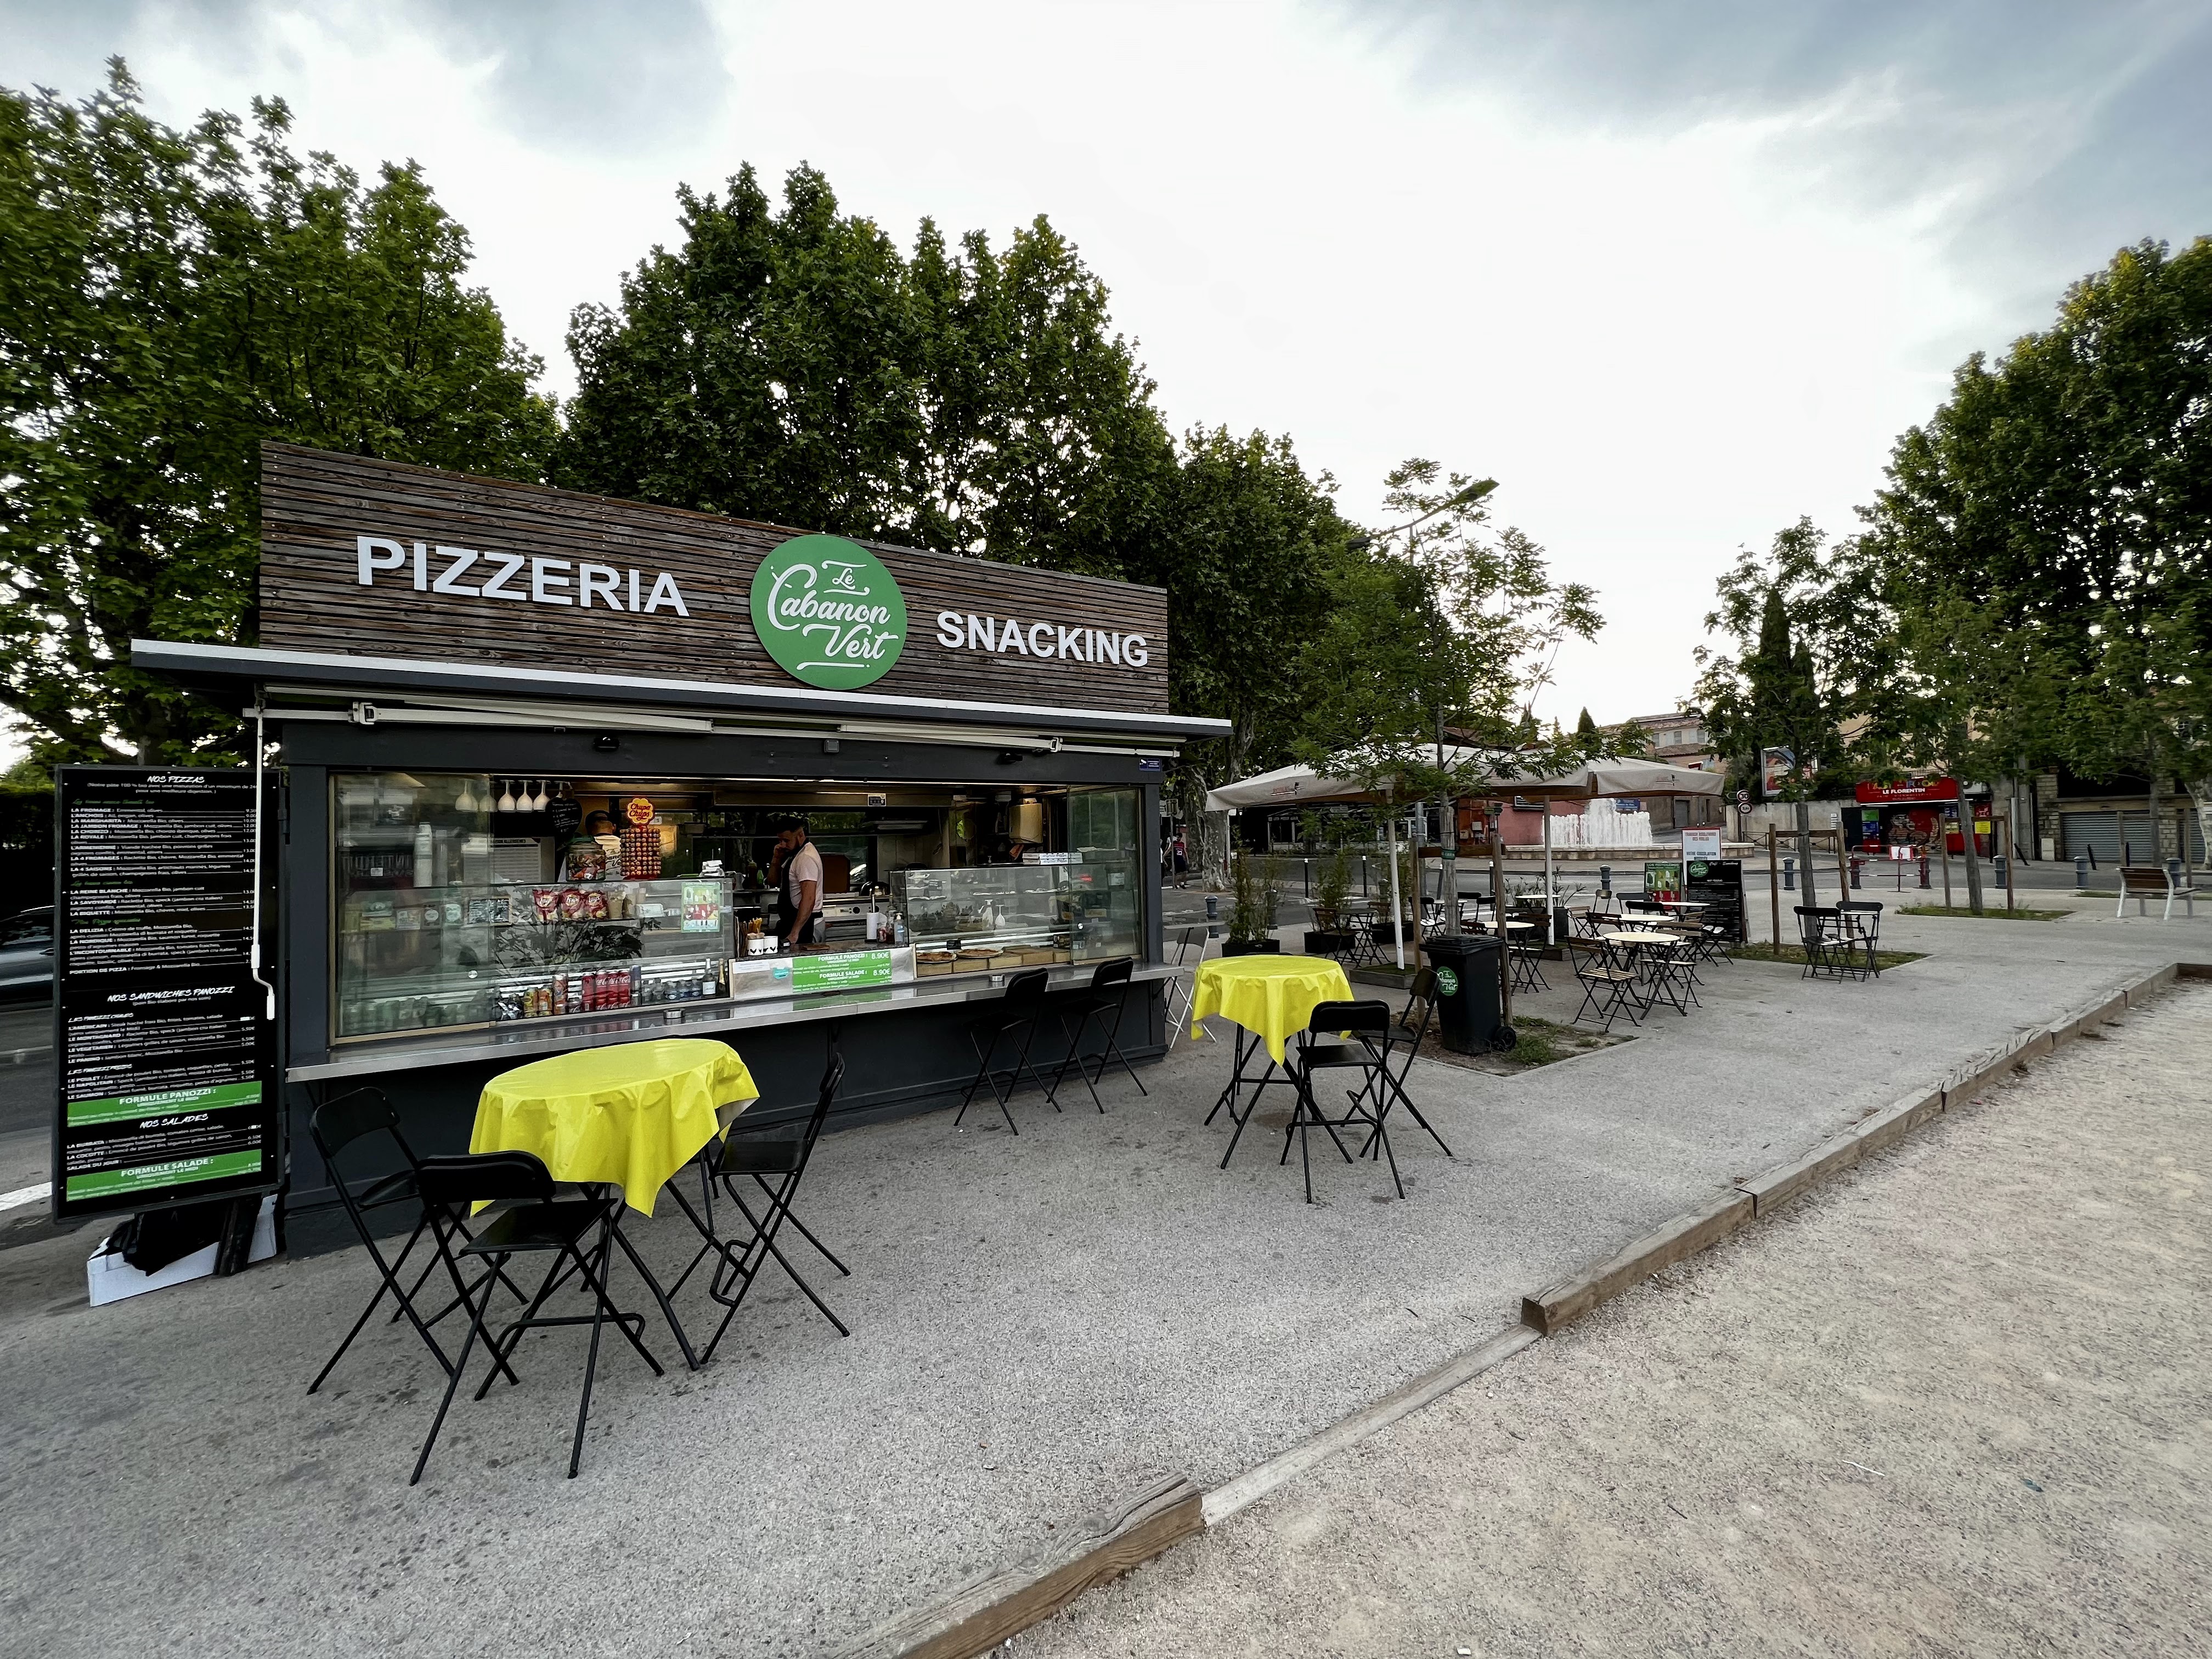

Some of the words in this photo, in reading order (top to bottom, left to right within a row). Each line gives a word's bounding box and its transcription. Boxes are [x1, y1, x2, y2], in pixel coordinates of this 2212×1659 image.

[357, 535, 689, 616] PIZZERIA
[768, 563, 891, 631] Cabanon
[803, 623, 899, 661] Vert
[936, 611, 1148, 667] SNACKING
[630, 810, 650, 819] Chups
[631, 803, 651, 811] Chupa
[107, 994, 127, 1002] NOS
[129, 989, 192, 1000] SANDWICHES
[193, 986, 235, 996] PANOZZI
[119, 1093, 167, 1104] FORMULE
[170, 1088, 211, 1098] PANOZZI
[139, 1120, 159, 1128] NOS
[161, 1113, 208, 1126] SALADES
[121, 1164, 170, 1177] FORMULE
[172, 1158, 208, 1169] SALADE
